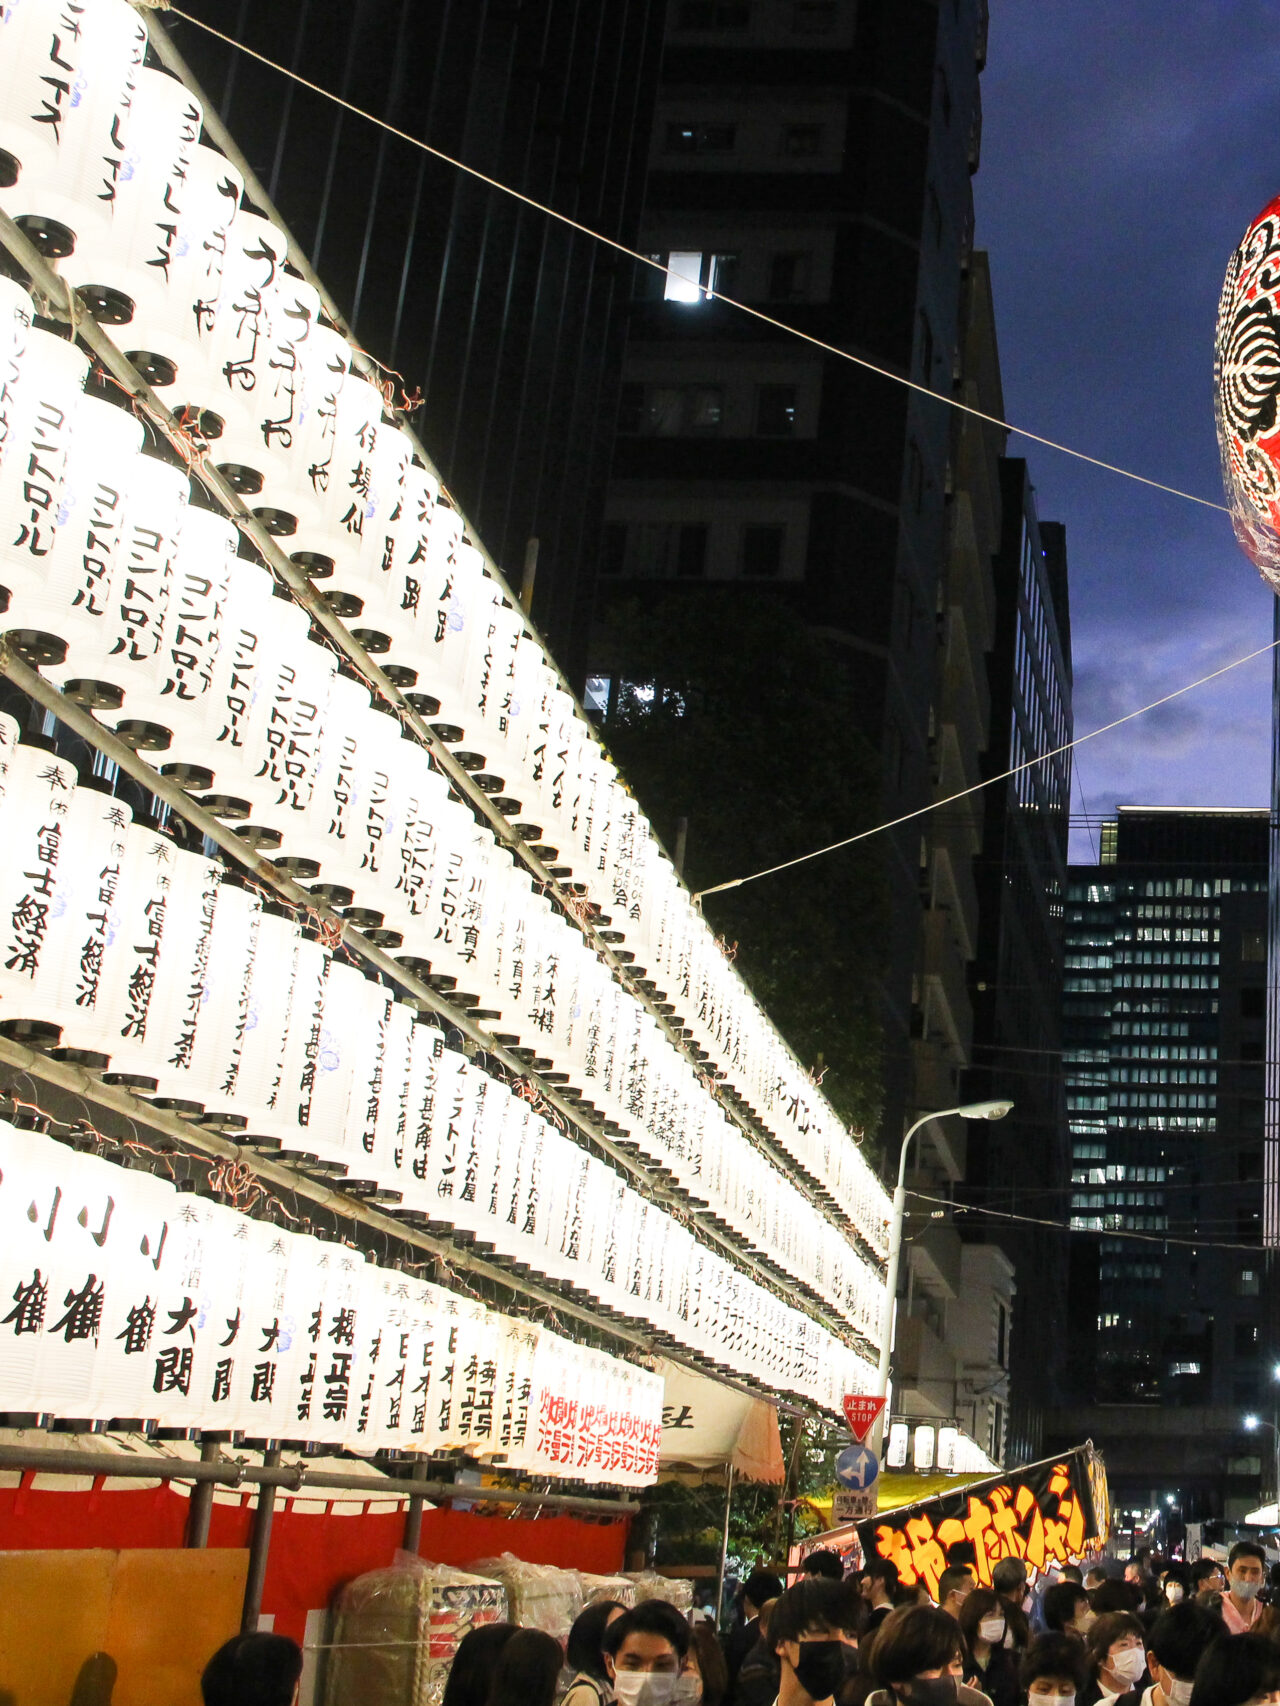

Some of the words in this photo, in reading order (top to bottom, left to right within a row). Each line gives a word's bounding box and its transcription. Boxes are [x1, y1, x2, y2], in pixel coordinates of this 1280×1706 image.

[152, 1296, 198, 1397] 大関
[847, 1400, 876, 1411] 止まれ
[852, 1412, 872, 1422] STOP
[836, 1505, 873, 1516] 一方通行
